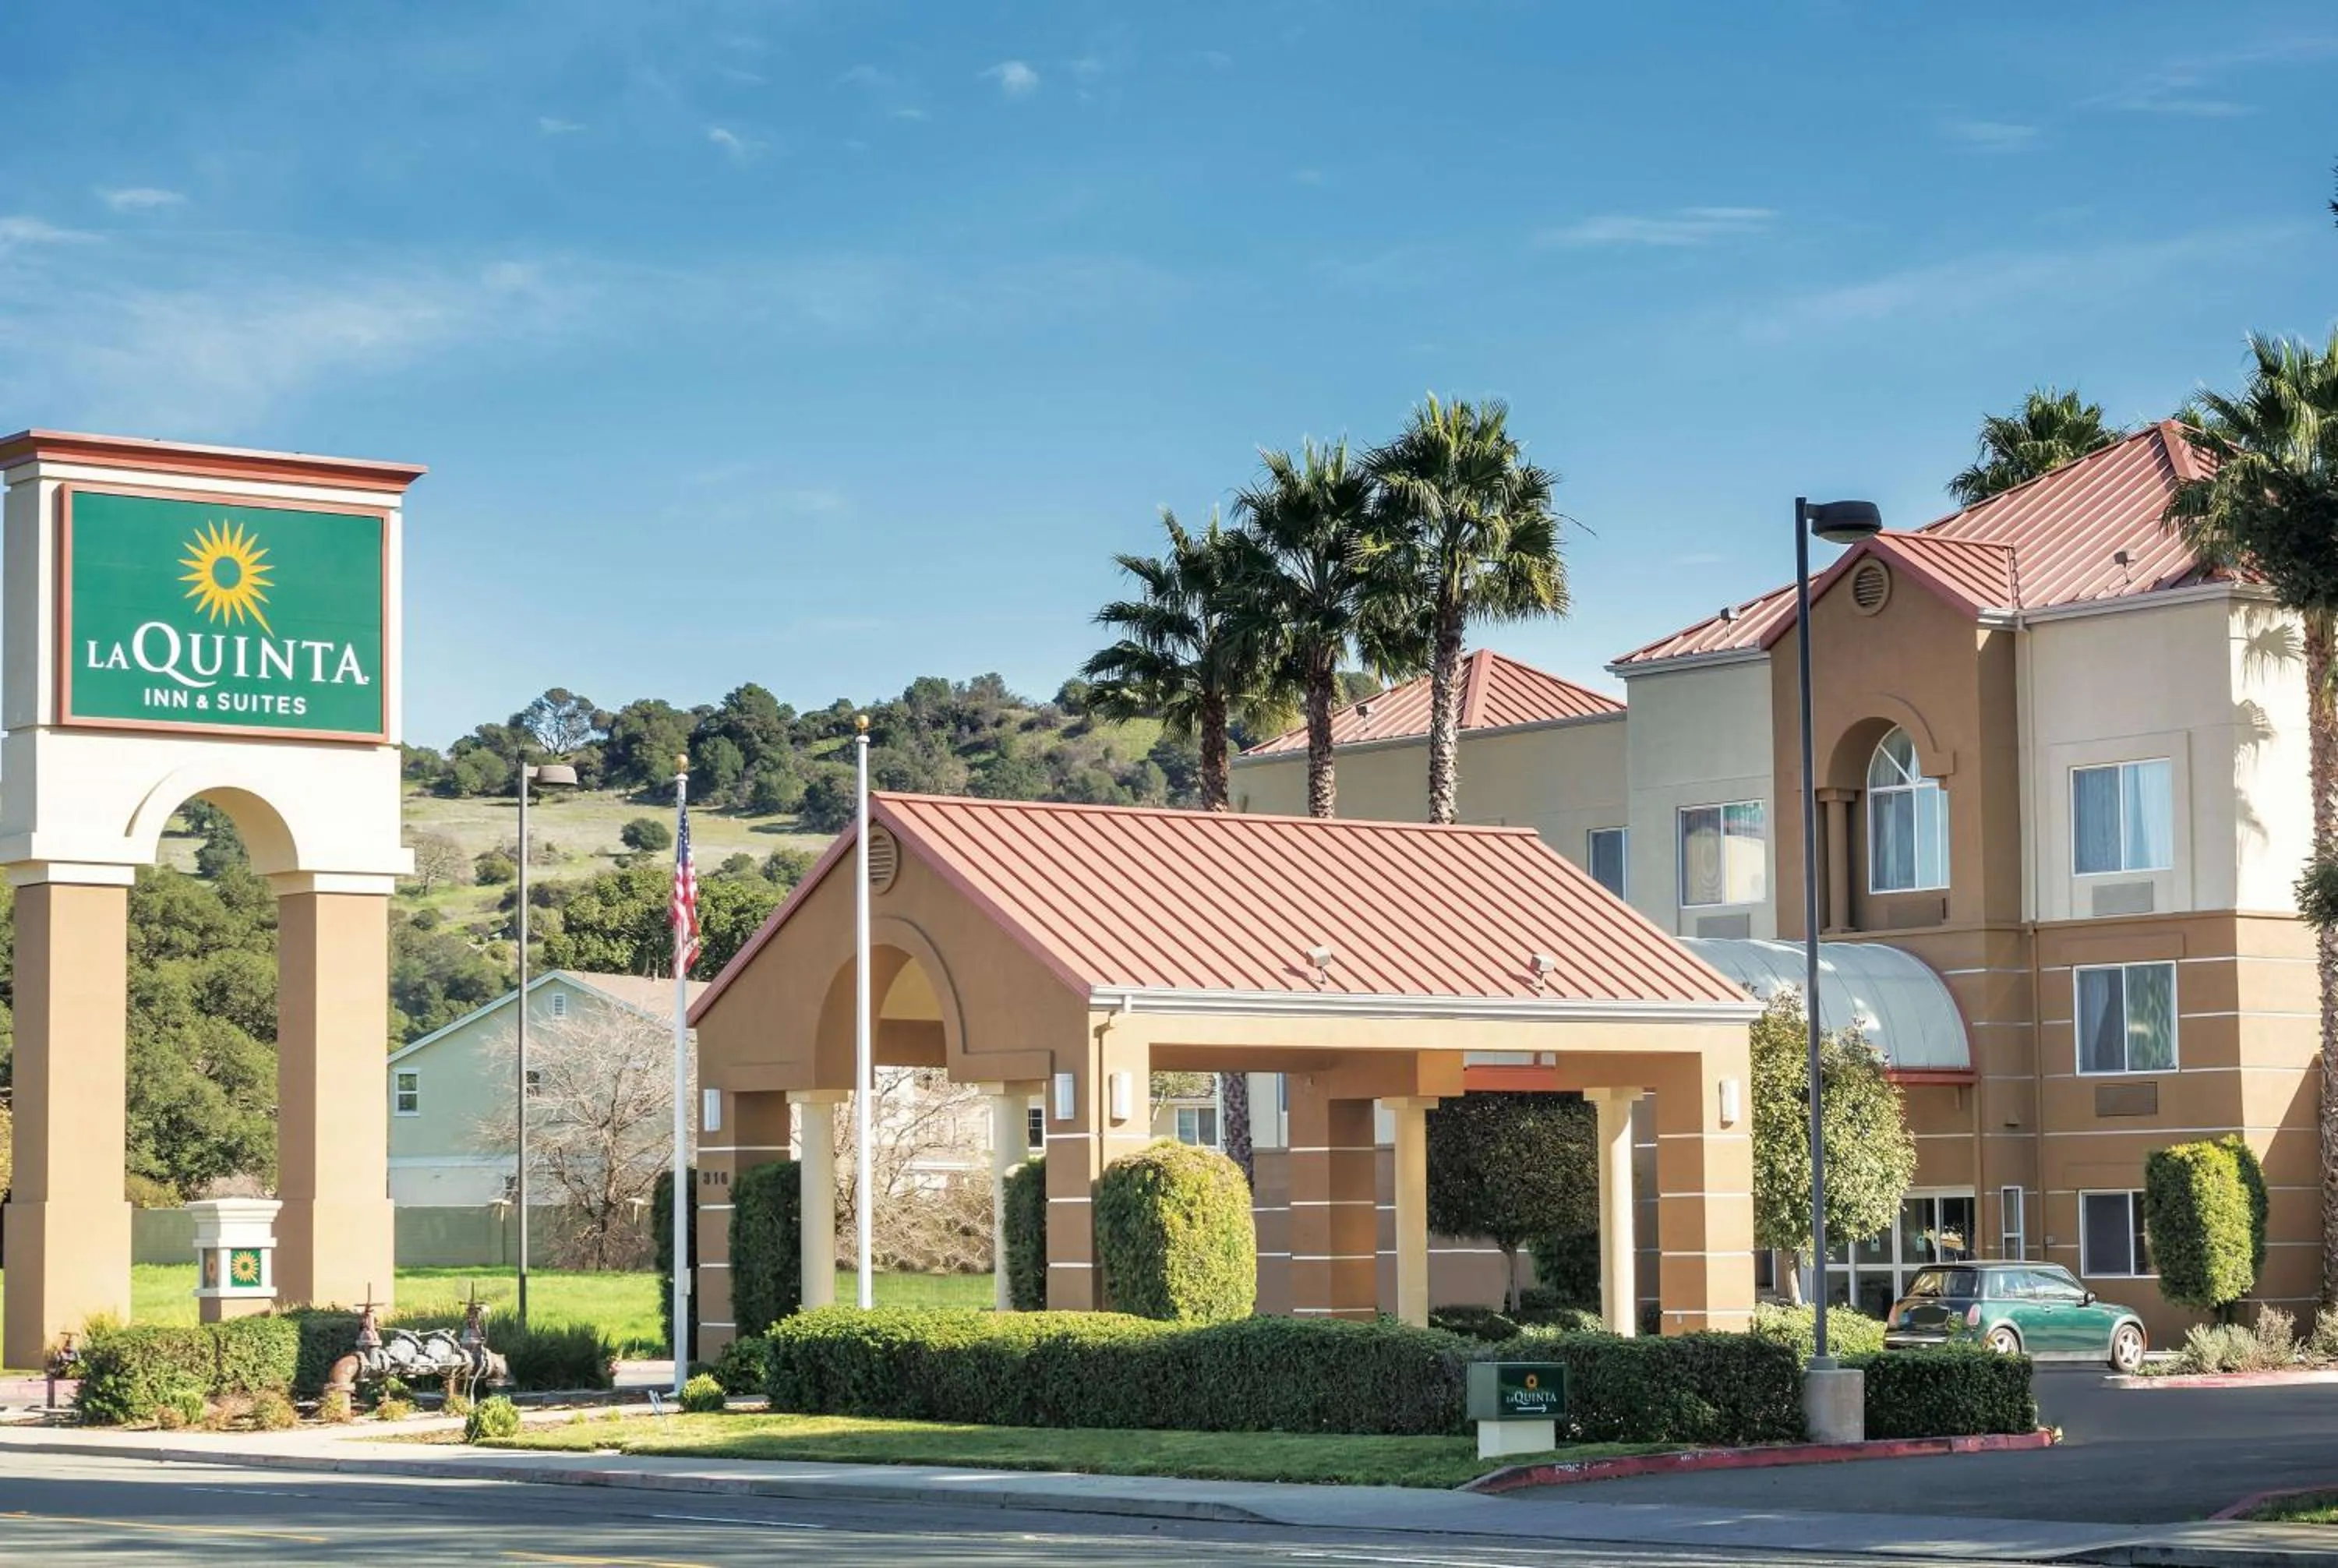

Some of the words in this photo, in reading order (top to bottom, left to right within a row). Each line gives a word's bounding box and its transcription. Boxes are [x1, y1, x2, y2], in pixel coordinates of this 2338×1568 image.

[87, 640, 131, 669] LA
[132, 621, 369, 688] QUINTA
[144, 687, 188, 708] INN
[196, 693, 209, 710] &
[217, 692, 307, 715] SUITES
[703, 1171, 729, 1185] 316
[1514, 1390, 1557, 1405] QUINTA
